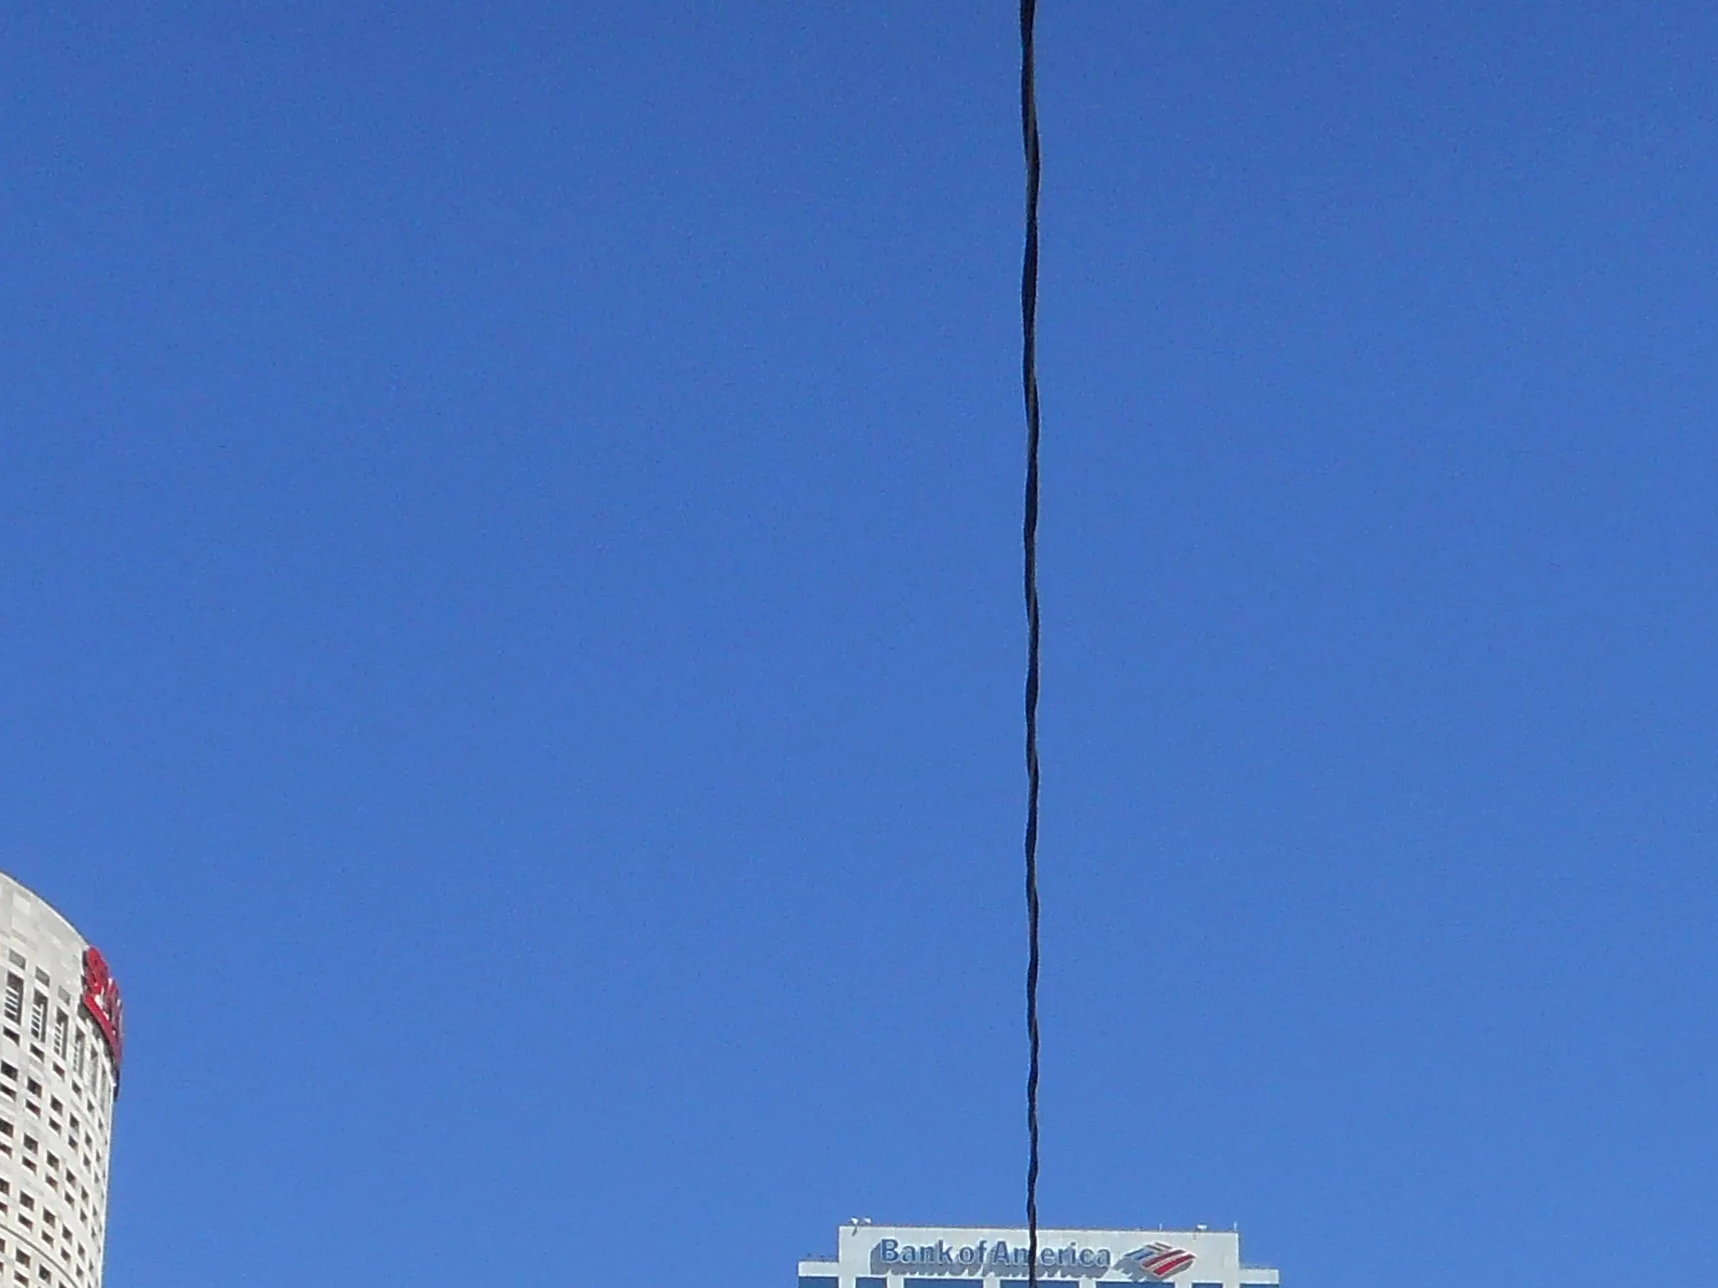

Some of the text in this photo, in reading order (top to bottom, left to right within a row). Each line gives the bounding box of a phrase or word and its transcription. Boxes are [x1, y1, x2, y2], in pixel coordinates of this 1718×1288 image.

[880, 1238, 1111, 1266] Bank of America
